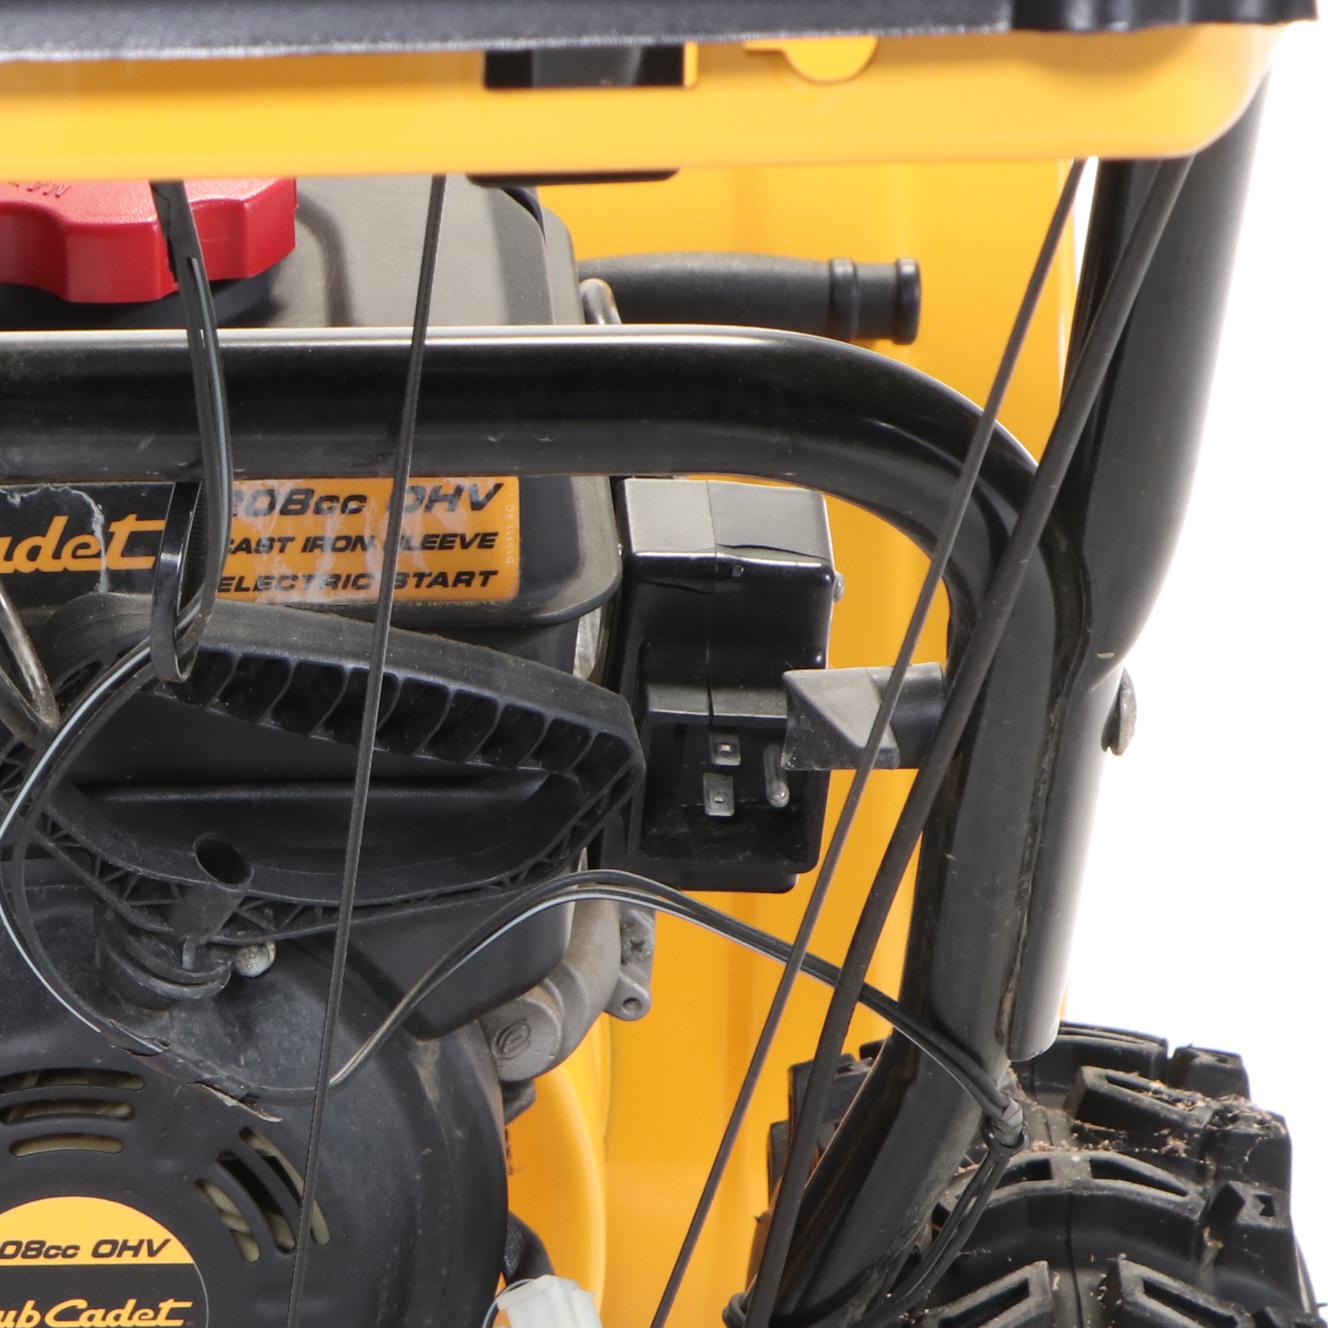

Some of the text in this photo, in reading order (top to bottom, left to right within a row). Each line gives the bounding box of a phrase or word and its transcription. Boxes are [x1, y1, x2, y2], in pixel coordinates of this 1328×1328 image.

[301, 534, 376, 554] IRON
[399, 531, 499, 551] LEEVE
[217, 573, 372, 593] ELECTRIC
[91, 1238, 171, 1258] OHV
[44, 1298, 193, 1328] Cadet
